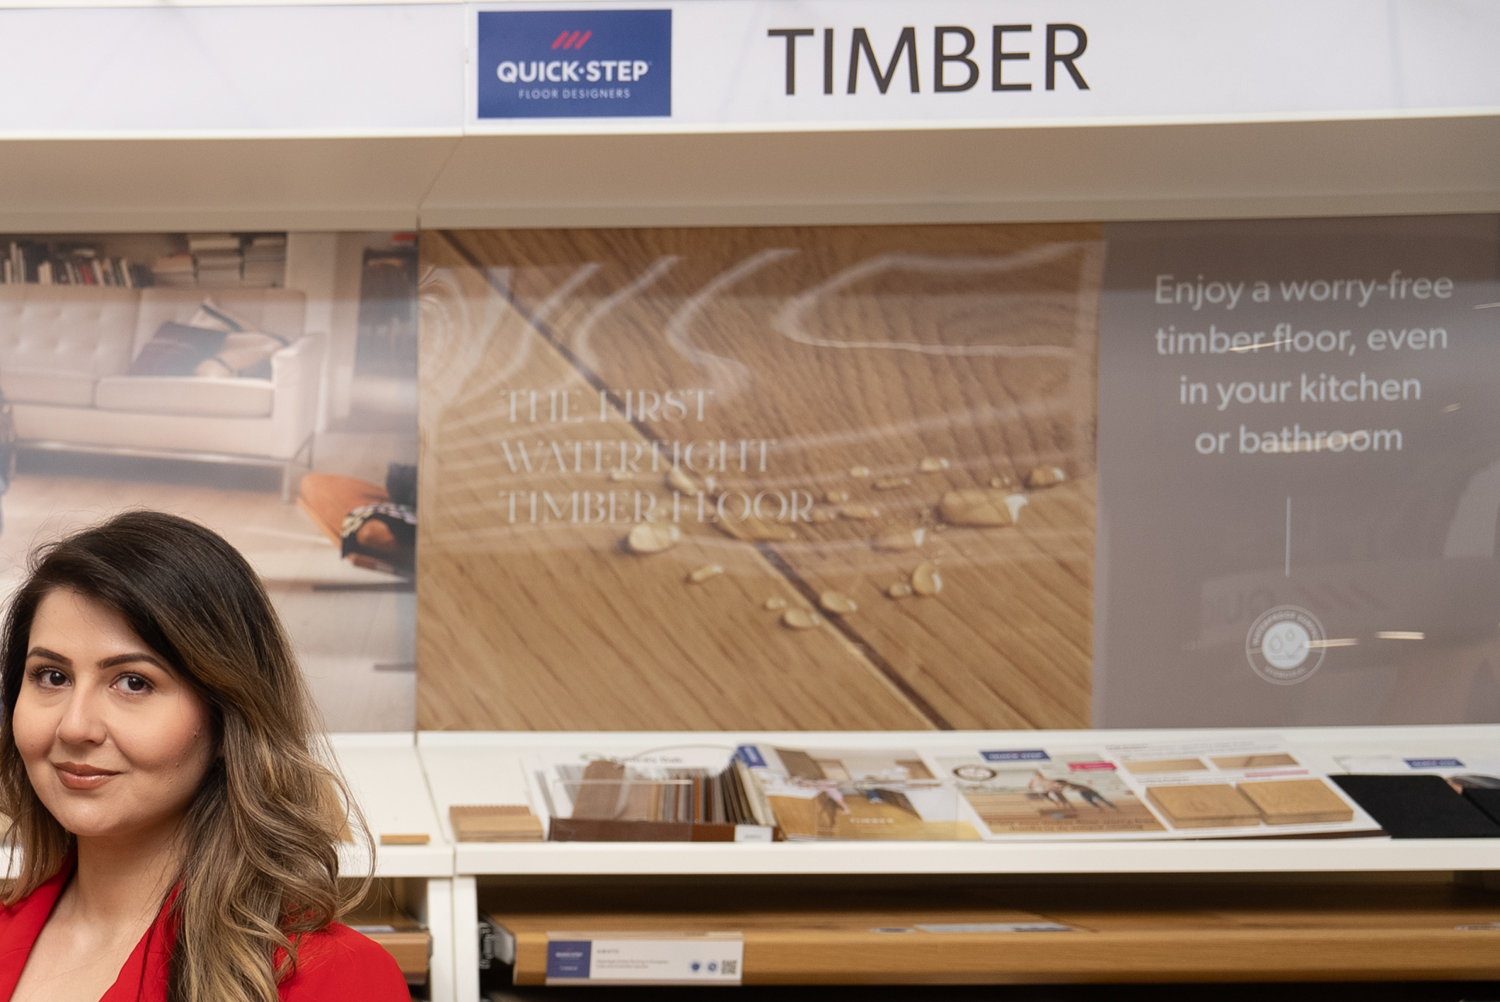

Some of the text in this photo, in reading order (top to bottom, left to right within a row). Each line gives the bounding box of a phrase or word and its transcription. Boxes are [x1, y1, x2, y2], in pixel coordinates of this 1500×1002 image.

[768, 23, 1091, 96] TIMBER
[518, 87, 631, 99] FLOOR DESIGNERS
[1155, 270, 1454, 310] Enjoy a worry-free
[1155, 323, 1449, 357] timber floor, even
[500, 388, 716, 424] THE FIRST
[1180, 372, 1422, 411] in your kitchen
[501, 438, 779, 474] WATERTIGHT
[1195, 424, 1403, 454] or bathroom
[500, 489, 815, 524] TIMBER FLOOR
